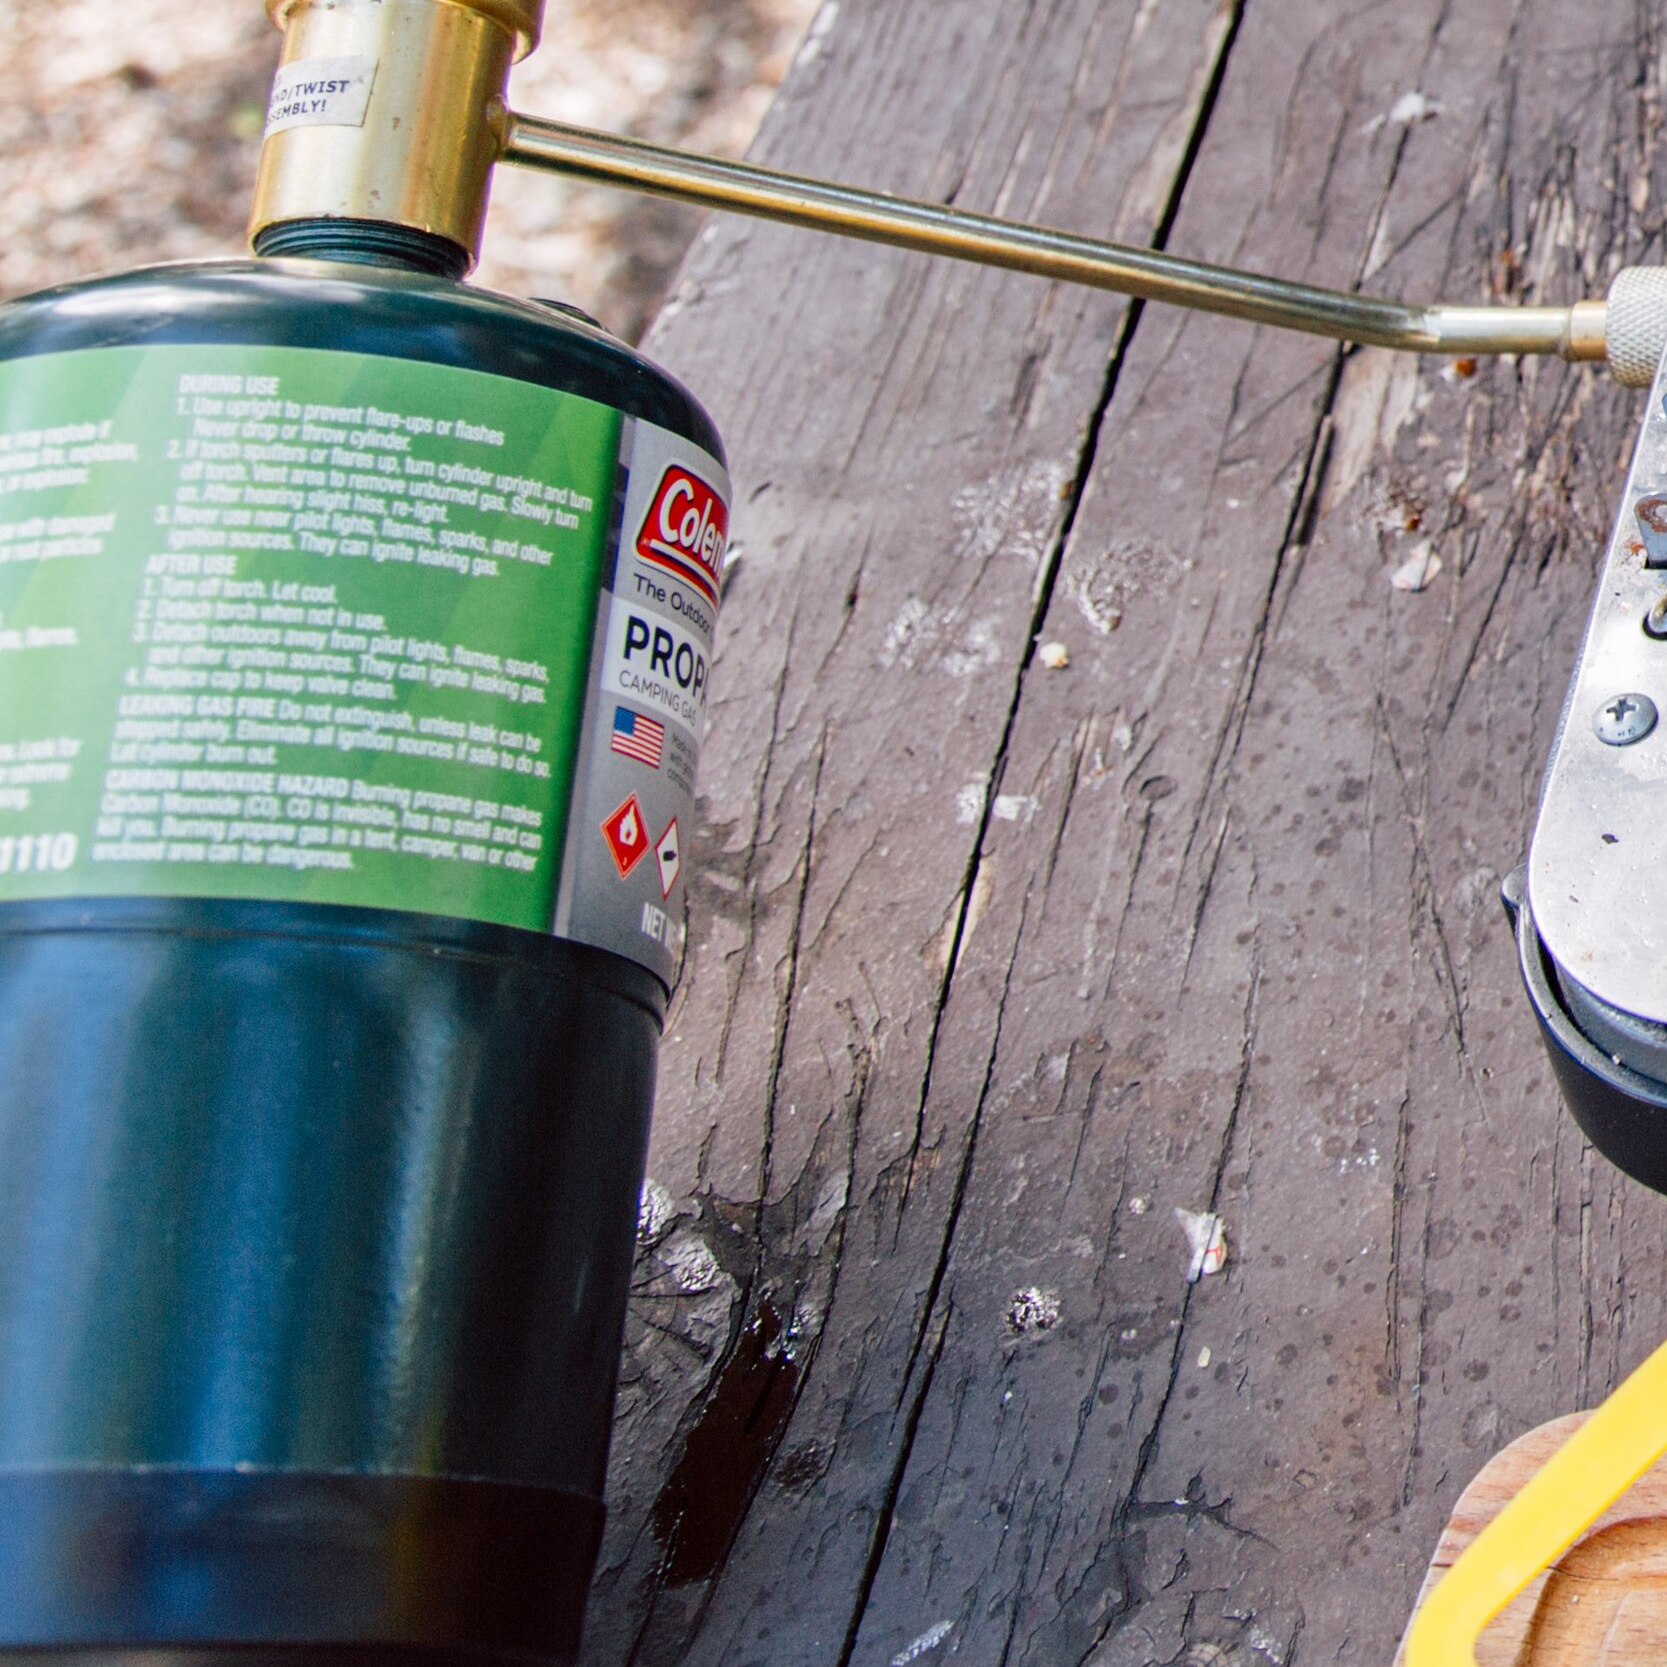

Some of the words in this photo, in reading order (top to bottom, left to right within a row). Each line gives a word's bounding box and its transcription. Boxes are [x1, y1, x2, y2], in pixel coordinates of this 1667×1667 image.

[303, 404, 362, 424] prevent
[366, 407, 432, 434] flare-ups
[436, 419, 452, 434] or
[455, 420, 504, 445] flashes
[329, 470, 344, 488] to
[348, 473, 405, 494] remove
[409, 480, 477, 505] unburned
[511, 496, 551, 525] Slowly
[555, 508, 578, 529] turn
[330, 446, 373, 469] flares
[405, 456, 434, 475] turn
[438, 464, 493, 486] cylinder
[496, 475, 542, 498] upright
[544, 485, 566, 504] and
[569, 491, 592, 512] turn
[339, 539, 368, 555] can
[372, 540, 414, 563] ignite
[417, 546, 469, 573] leaking
[492, 538, 517, 558] and
[520, 543, 553, 566] other
[633, 572, 666, 602] The
[337, 608, 351, 625] in
[330, 630, 367, 651] from
[370, 636, 403, 656] pilot
[359, 654, 396, 679] They
[399, 663, 427, 680] can
[429, 665, 468, 688] ignite
[471, 671, 519, 702] leaking
[619, 669, 680, 712] CAMPING
[336, 729, 393, 752] ignition
[396, 736, 453, 759] sources
[456, 741, 467, 760] if
[468, 746, 497, 767] safe
[501, 750, 514, 770] to
[516, 754, 533, 773] do
[418, 716, 465, 737] unless
[468, 721, 497, 743] leak
[500, 730, 523, 747] can
[525, 732, 541, 753] be
[642, 901, 666, 942] NET
